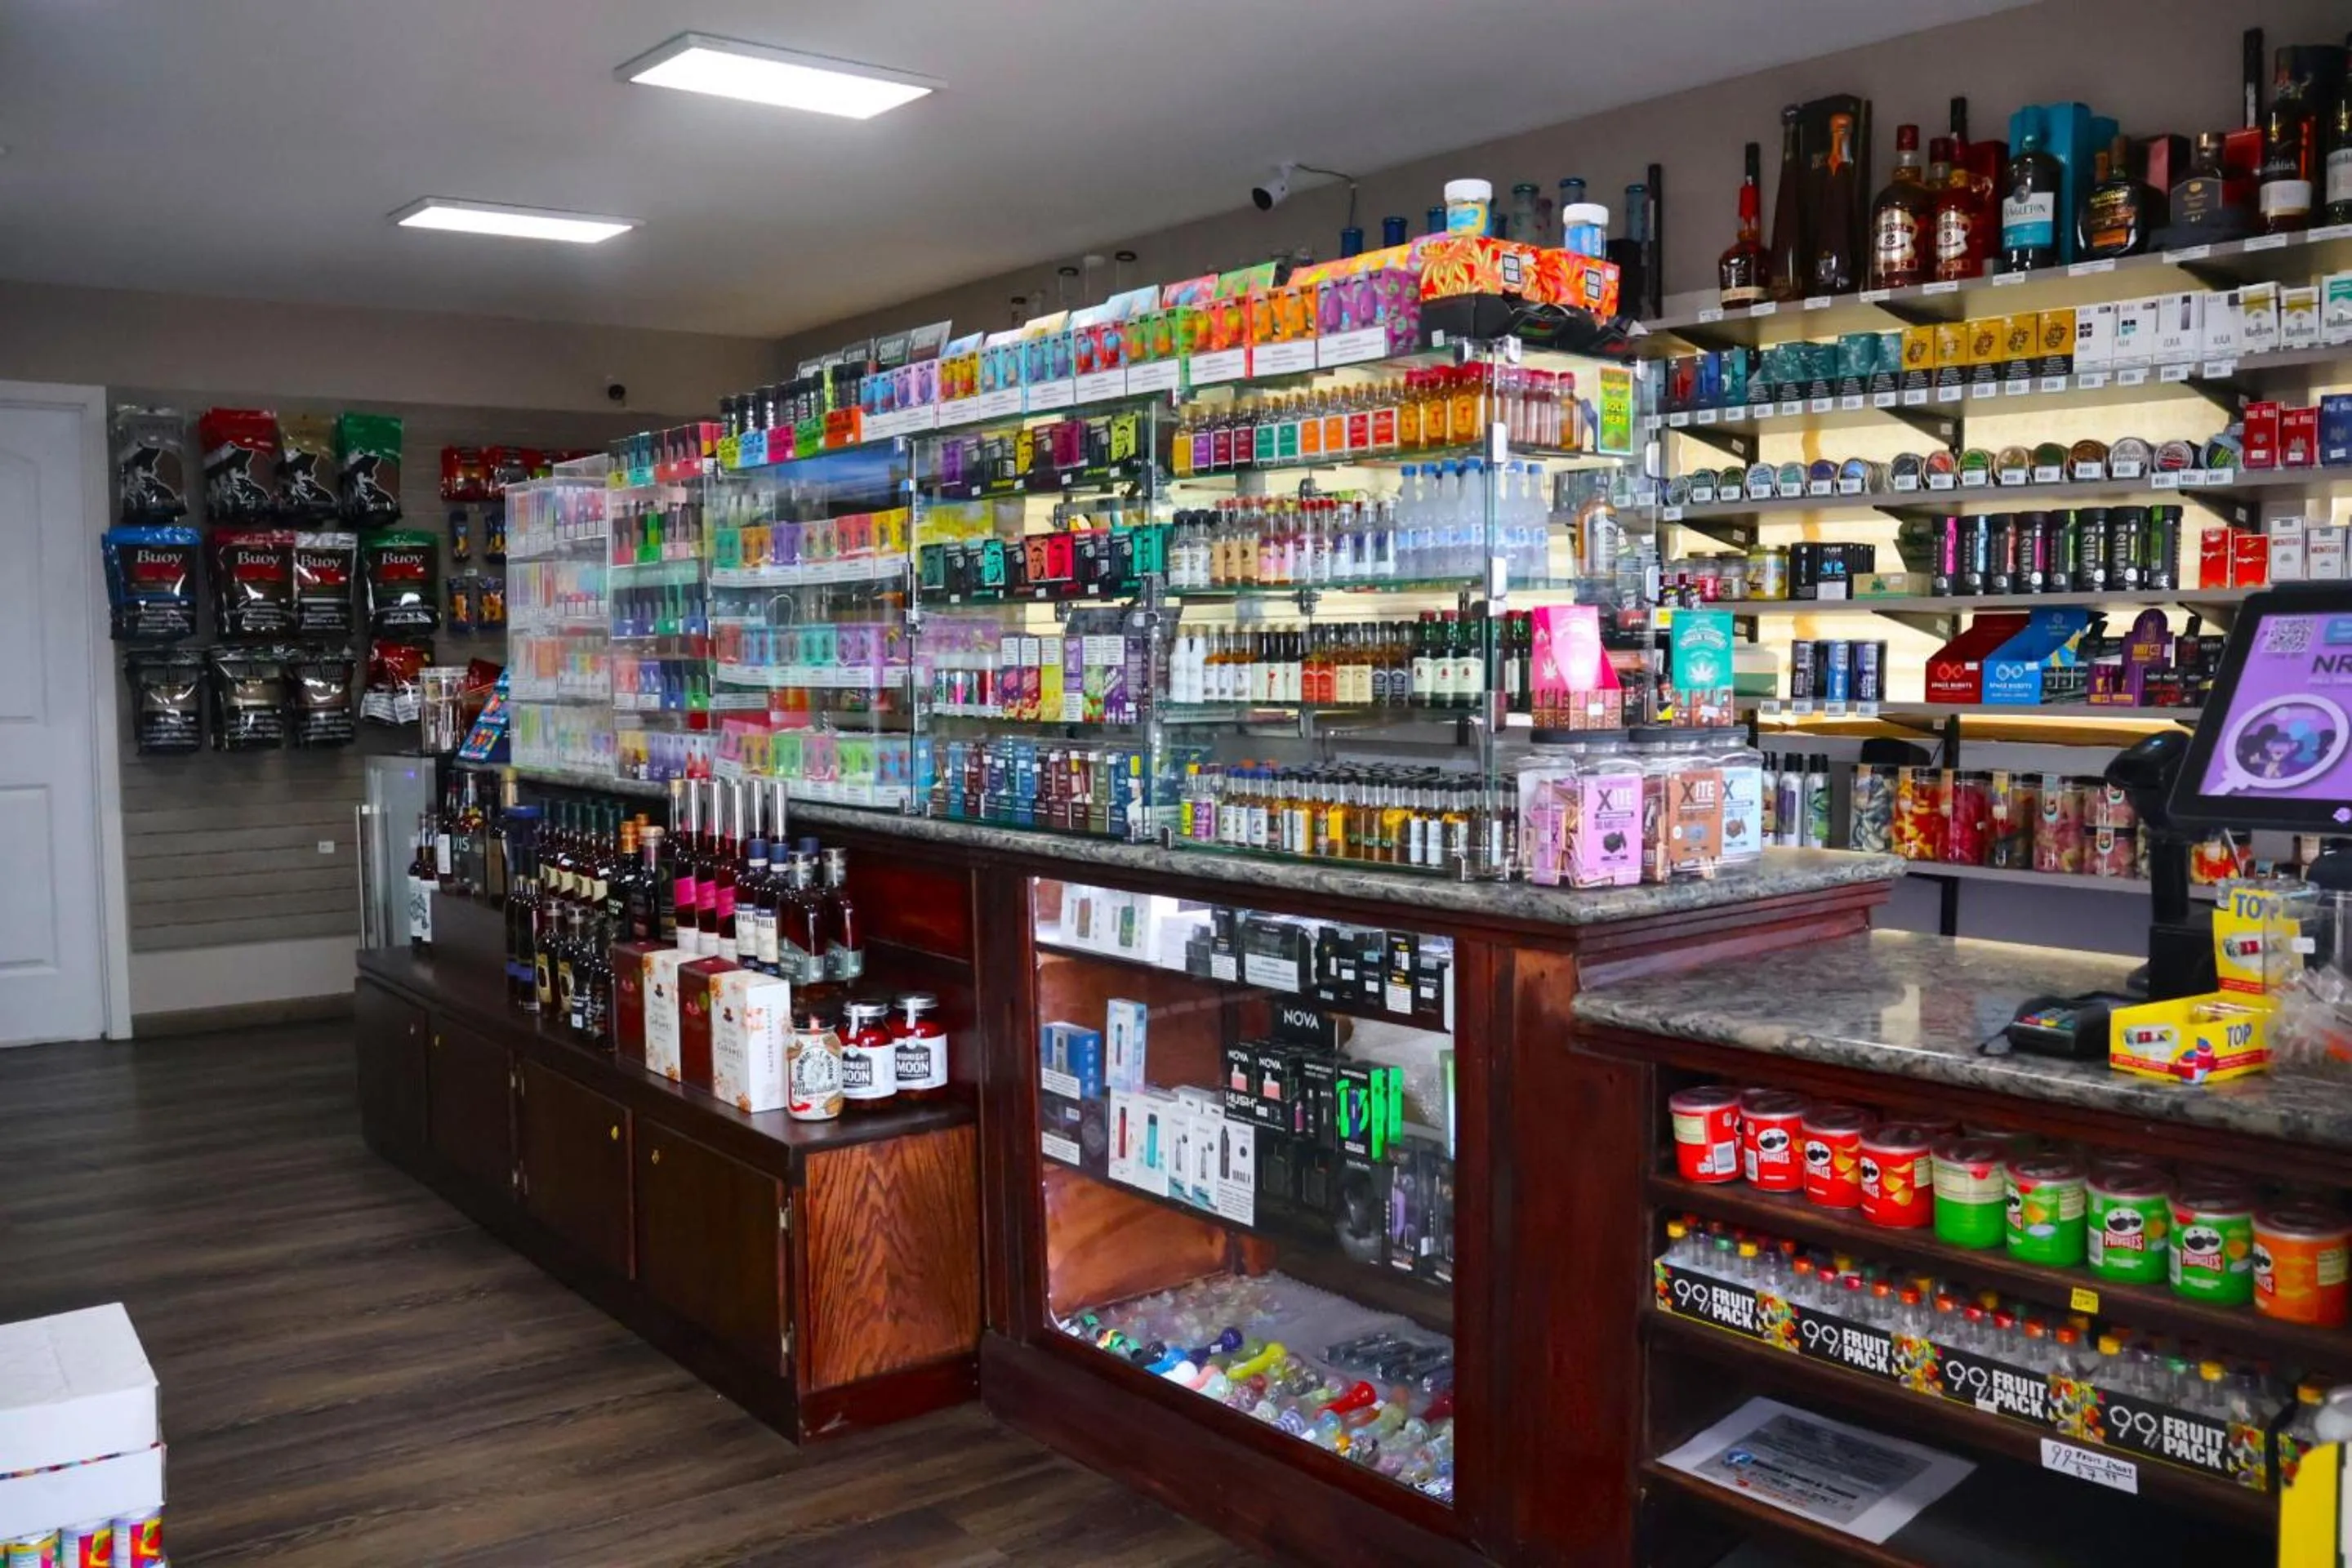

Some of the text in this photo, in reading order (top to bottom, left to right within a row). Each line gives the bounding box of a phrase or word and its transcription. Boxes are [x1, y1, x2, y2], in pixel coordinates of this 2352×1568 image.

[136, 550, 183, 565] Buoy
[237, 551, 281, 566] Buoy
[301, 555, 342, 569] Buoy
[381, 552, 425, 565] Buoy
[1597, 789, 1633, 811] XITE
[1682, 781, 1715, 803] XITE
[1283, 1009, 1320, 1030] NOVA
[2226, 1023, 2252, 1047] TOP
[897, 1062, 929, 1074] MOON
[1227, 1050, 1249, 1062] NOVA
[1258, 1057, 1282, 1071] NOVA
[1674, 1279, 1708, 1312] 99
[1712, 1285, 1755, 1313] FRUIT
[1713, 1303, 1753, 1330] PACK
[1802, 1319, 1839, 1354] 99
[1842, 1328, 1891, 1357] FRUIT
[1843, 1344, 1888, 1374] PACK
[1945, 1361, 1989, 1402] 99
[1992, 1370, 2047, 1401] FRUIT
[1993, 1387, 2044, 1419] PACK
[2109, 1405, 2158, 1446] 99
[2163, 1415, 2225, 1448] FRUIT
[2051, 1445, 2072, 1467] 99
[2163, 1434, 2222, 1469] PACK
